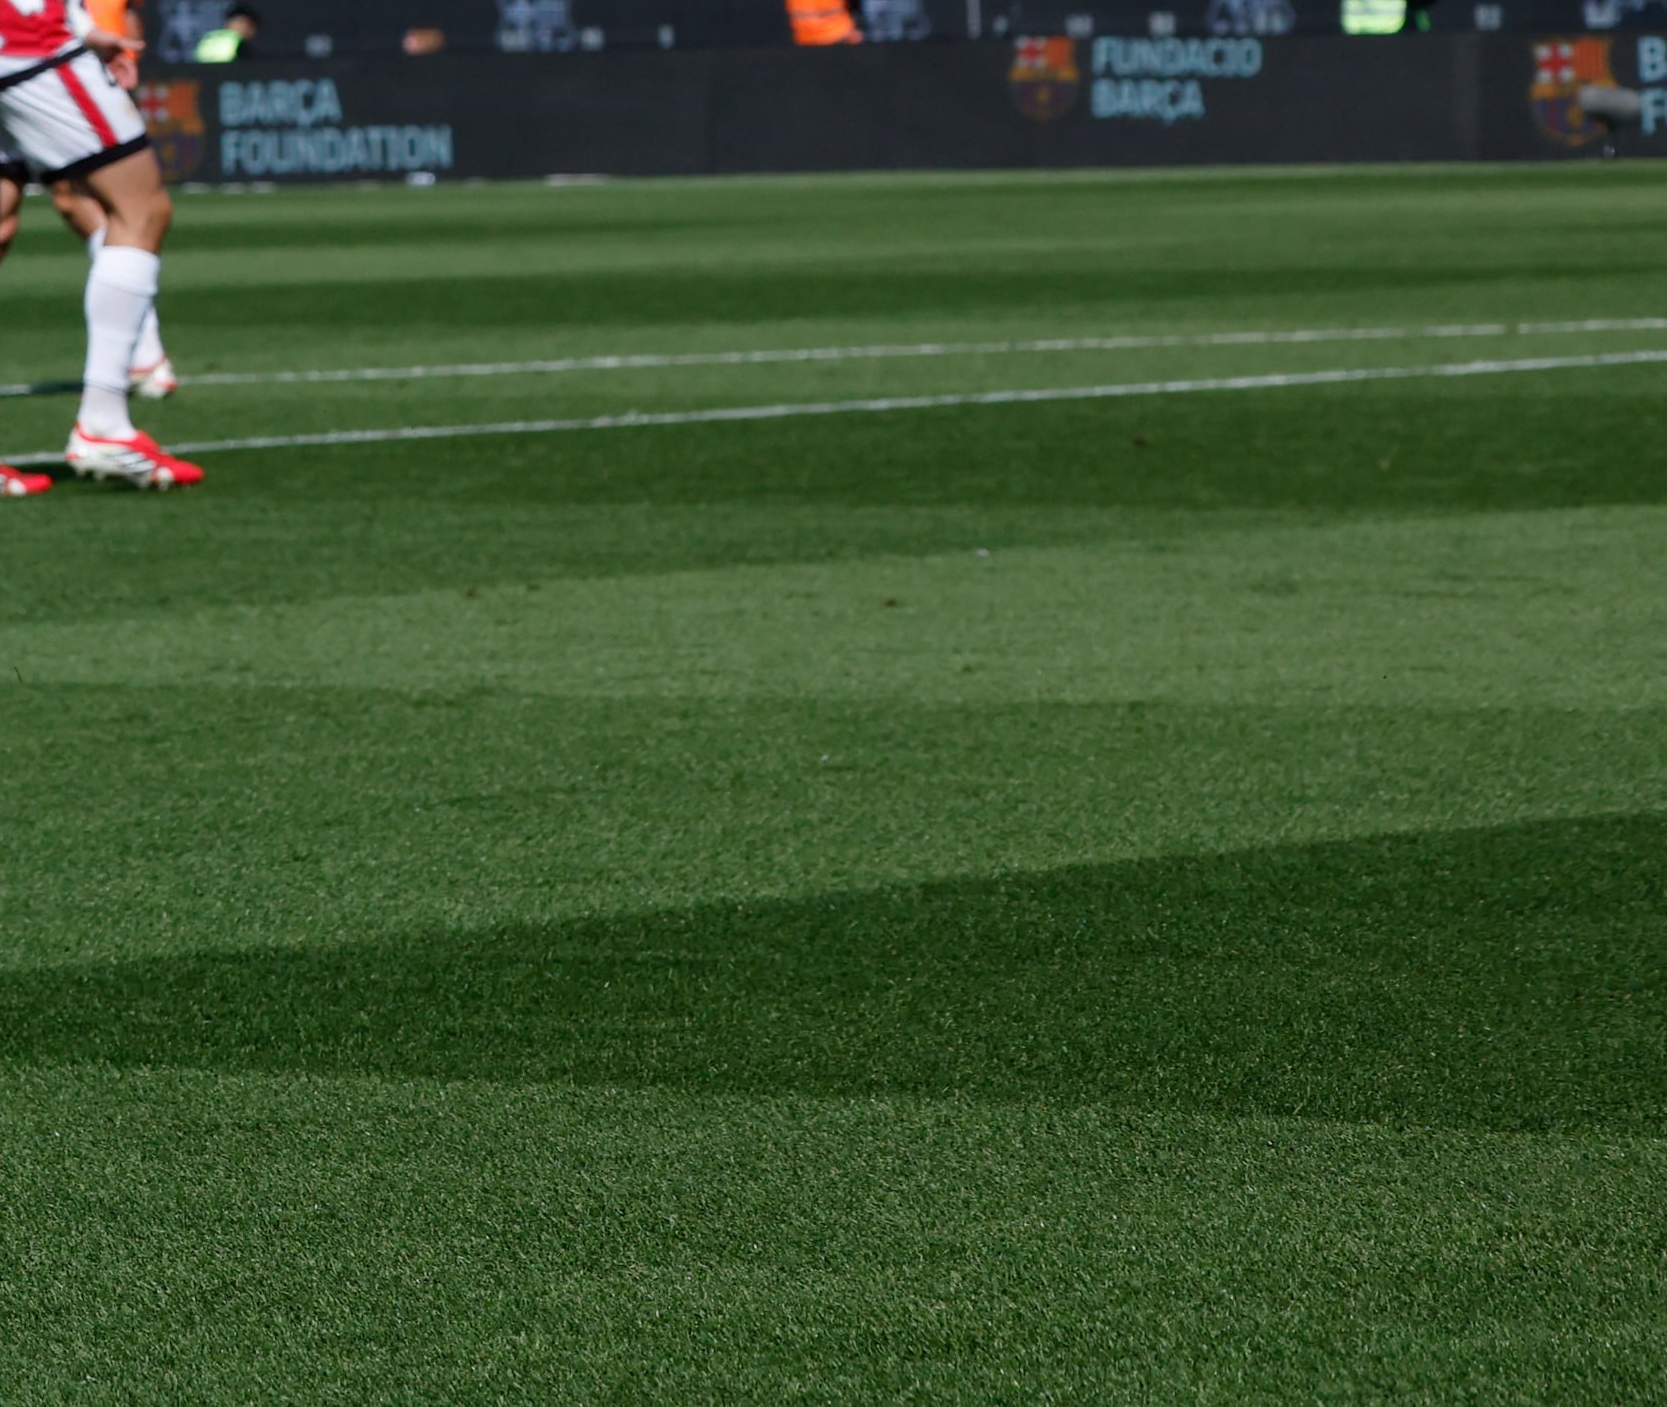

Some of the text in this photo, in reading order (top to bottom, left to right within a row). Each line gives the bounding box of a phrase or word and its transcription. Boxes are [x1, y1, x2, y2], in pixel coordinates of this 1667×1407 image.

[218, 78, 344, 128] BARÇA
[1090, 78, 1205, 125] BARÇA
[221, 124, 455, 176] FOUNDATION
